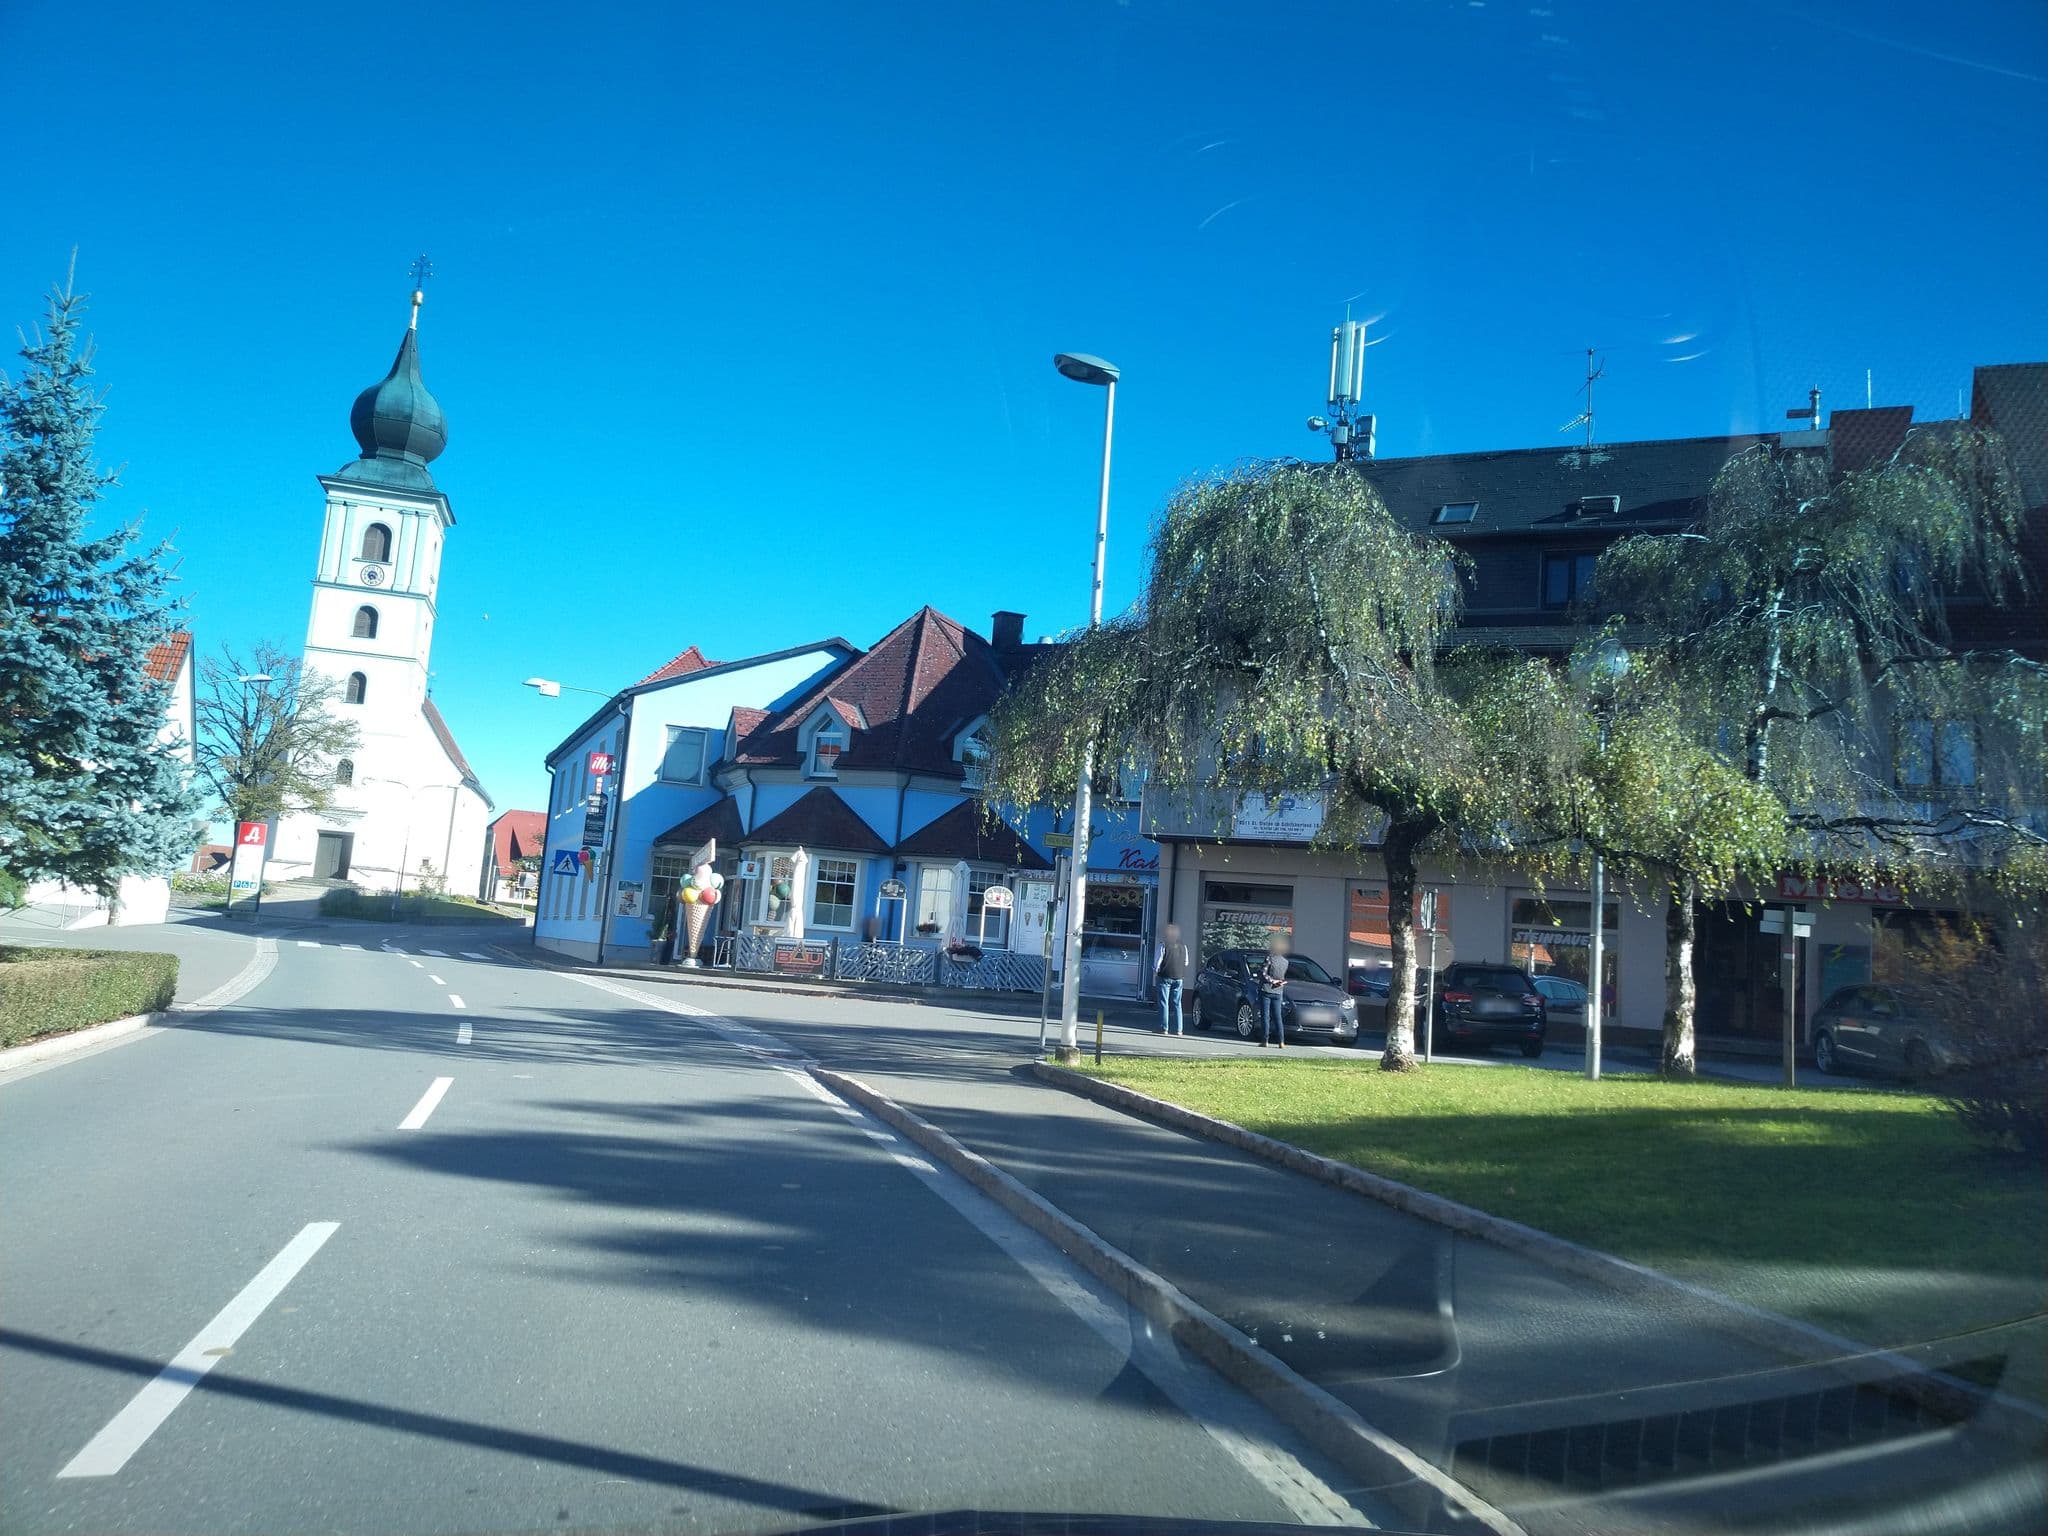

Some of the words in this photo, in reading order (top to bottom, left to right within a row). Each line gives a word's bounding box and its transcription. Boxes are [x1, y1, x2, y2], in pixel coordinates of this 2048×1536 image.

[591, 756, 612, 773] illy
[1119, 848, 1159, 870] Kai
[1514, 931, 1590, 947] STEINBAUE
